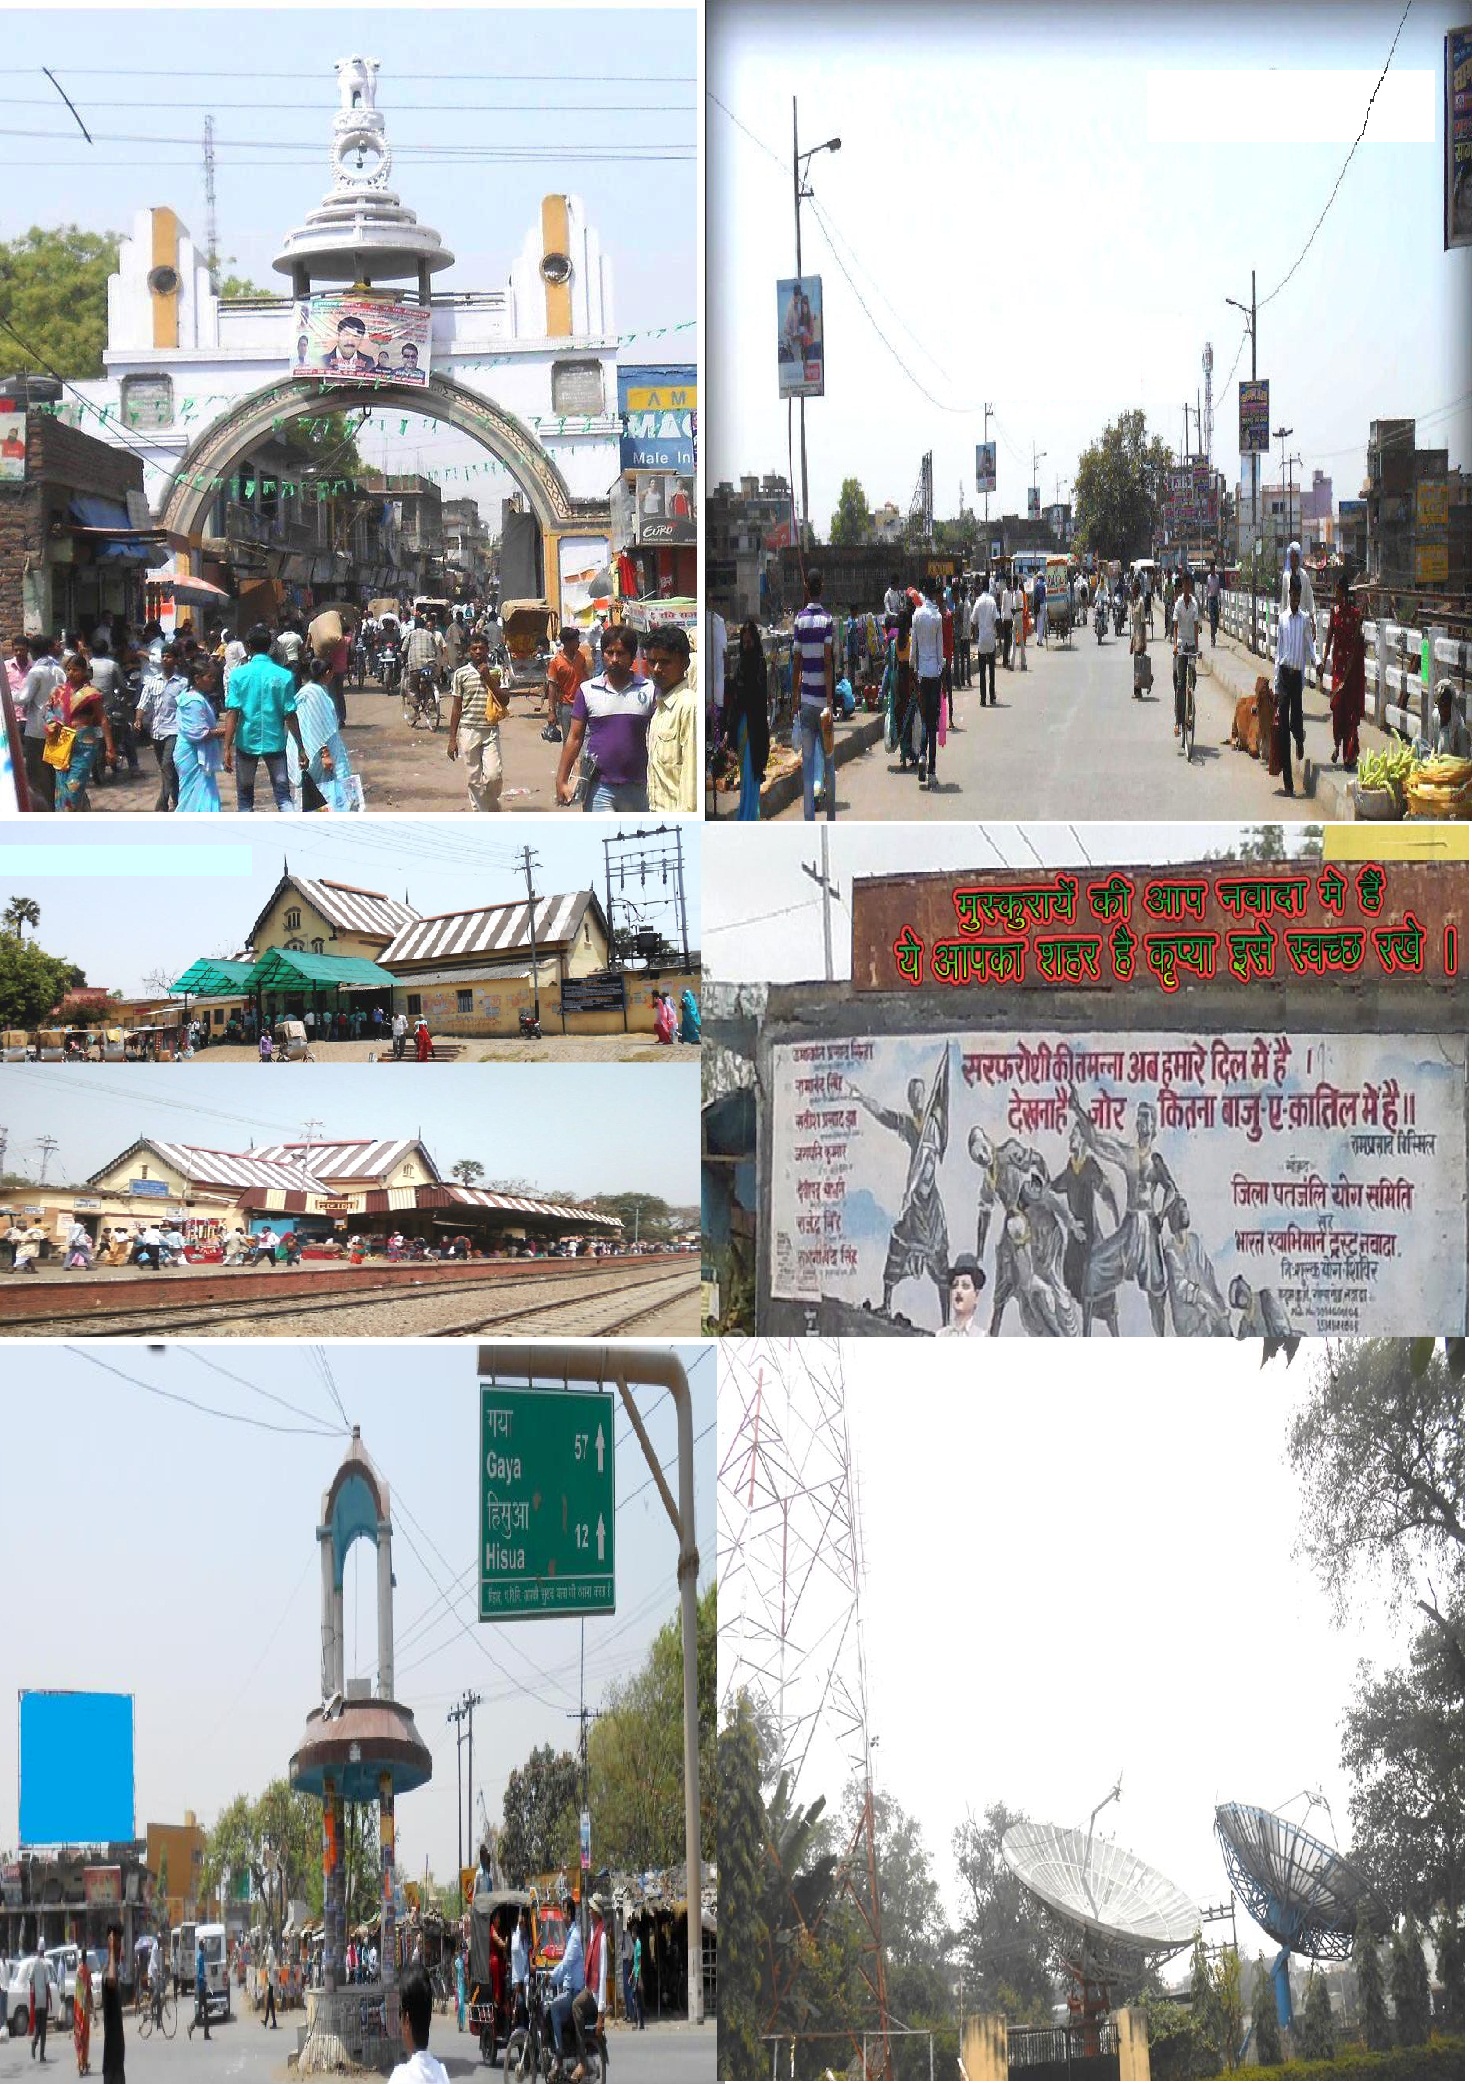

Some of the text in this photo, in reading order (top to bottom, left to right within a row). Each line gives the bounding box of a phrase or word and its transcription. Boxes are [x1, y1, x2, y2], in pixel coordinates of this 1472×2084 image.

[633, 451, 668, 464] Male
[642, 525, 673, 537] EURO
[1127, 1051, 1159, 1083] अब
[1162, 1040, 1207, 1089] हमारे
[1211, 1038, 1247, 1084] दिल
[1251, 1037, 1272, 1080] में
[1157, 1088, 1217, 1130] कितना
[1231, 1174, 1269, 1209] जिला
[1331, 1171, 1363, 1209] योग
[1365, 1178, 1414, 1212] समिति
[1235, 1230, 1265, 1257] भारत
[486, 1409, 514, 1437] गया
[574, 1434, 589, 1460] 57
[486, 1451, 521, 1485] Gaya
[486, 1491, 530, 1540] हिसुआ
[574, 1523, 589, 1548] 12
[485, 1543, 526, 1571] Hisua
